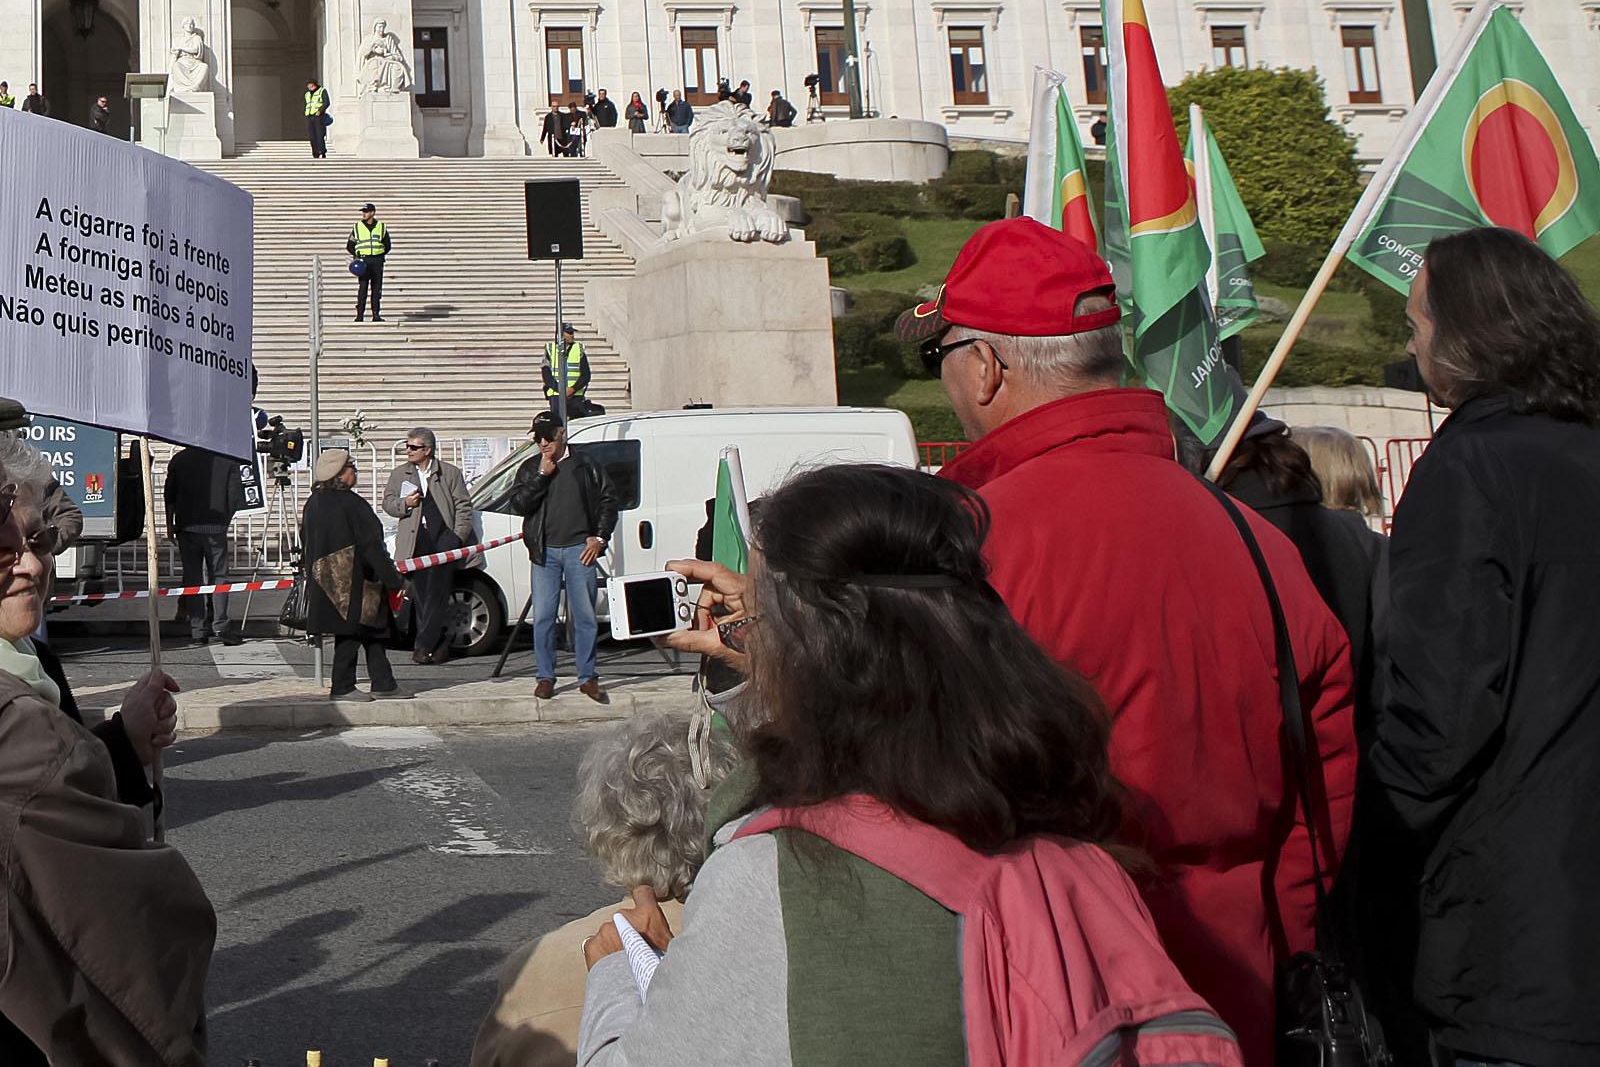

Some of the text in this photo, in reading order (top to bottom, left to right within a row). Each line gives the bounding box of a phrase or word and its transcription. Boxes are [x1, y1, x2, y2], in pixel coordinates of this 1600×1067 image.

[34, 232, 229, 307] A formiga foi depois
[35, 197, 231, 275] A cigarra foi à frente
[25, 263, 235, 342] Meteu as mãos á obra
[52, 311, 100, 336] quis
[107, 322, 173, 356] peritos
[179, 341, 249, 380] mamões!
[50, 426, 76, 441] IRS
